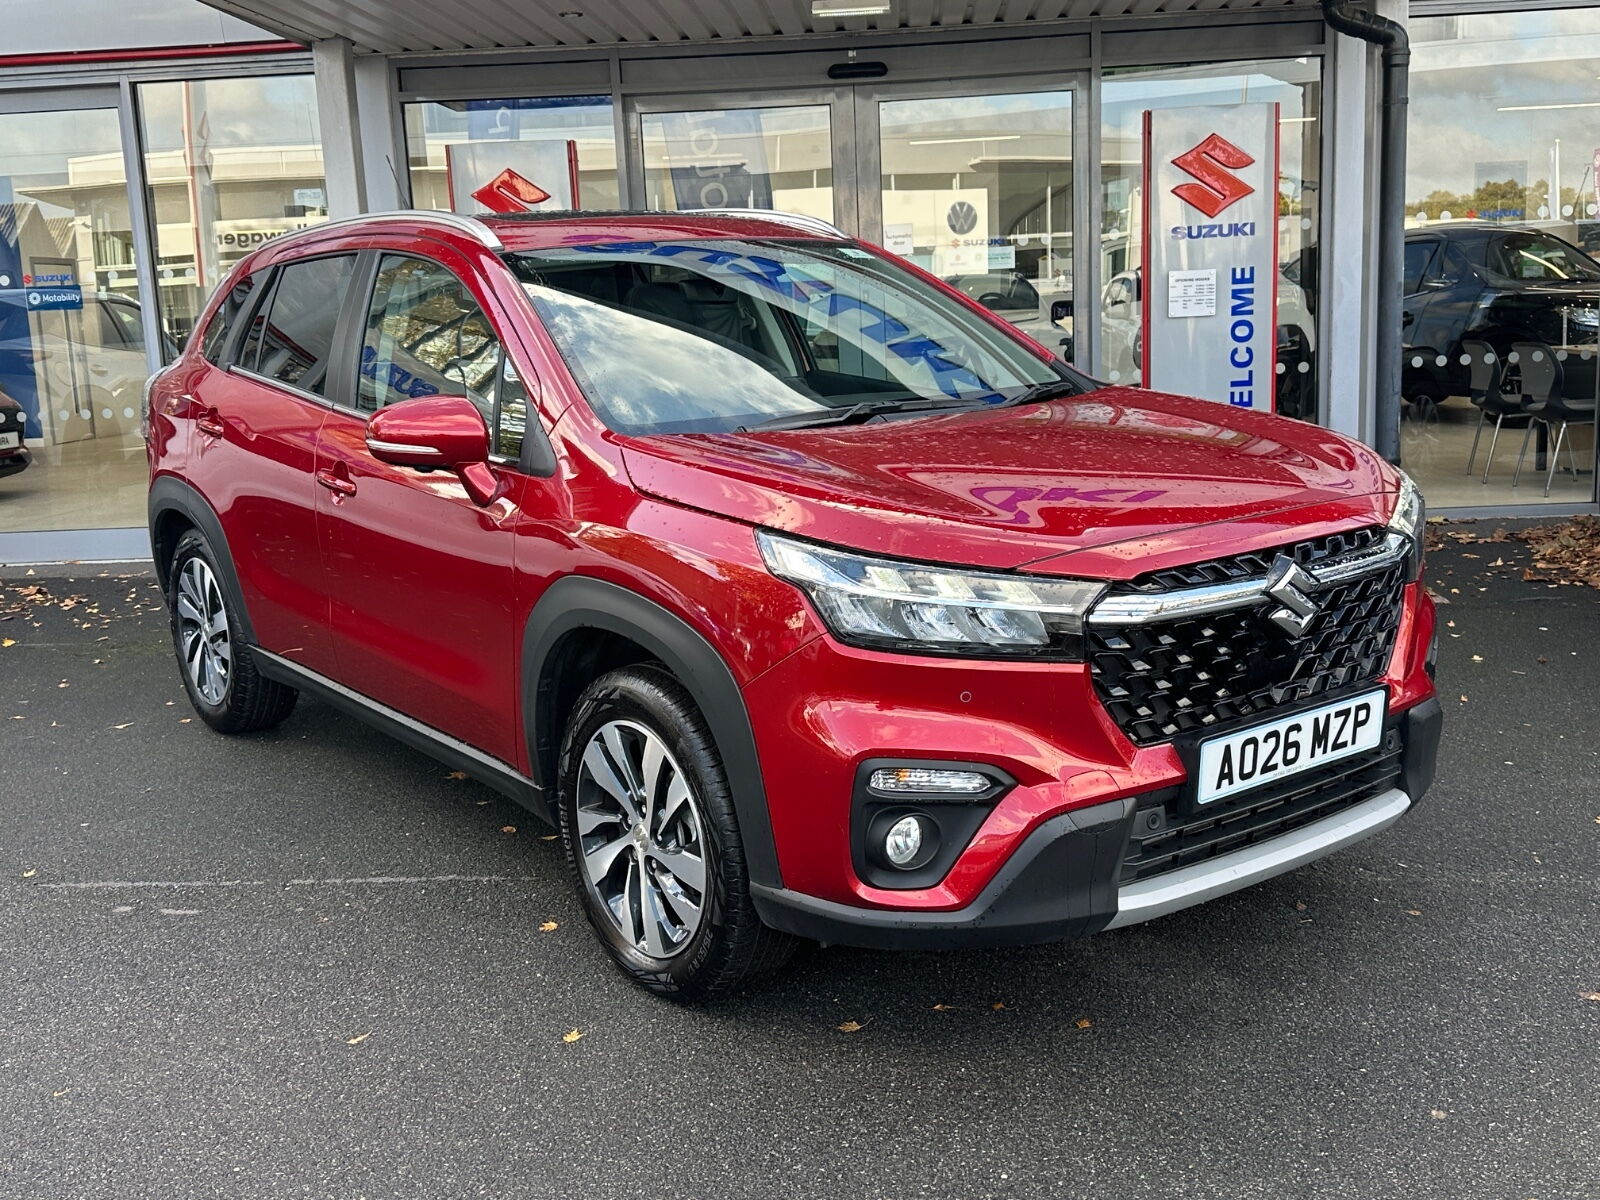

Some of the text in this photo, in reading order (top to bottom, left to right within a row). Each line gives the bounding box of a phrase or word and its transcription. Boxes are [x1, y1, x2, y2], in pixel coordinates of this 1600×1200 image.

[1171, 222, 1256, 240] SUZUKI
[34, 274, 76, 283] SUZUKI
[43, 293, 80, 303] Motability
[1230, 266, 1255, 408] ELCOME
[1215, 702, 1372, 791] AO26 MZP
